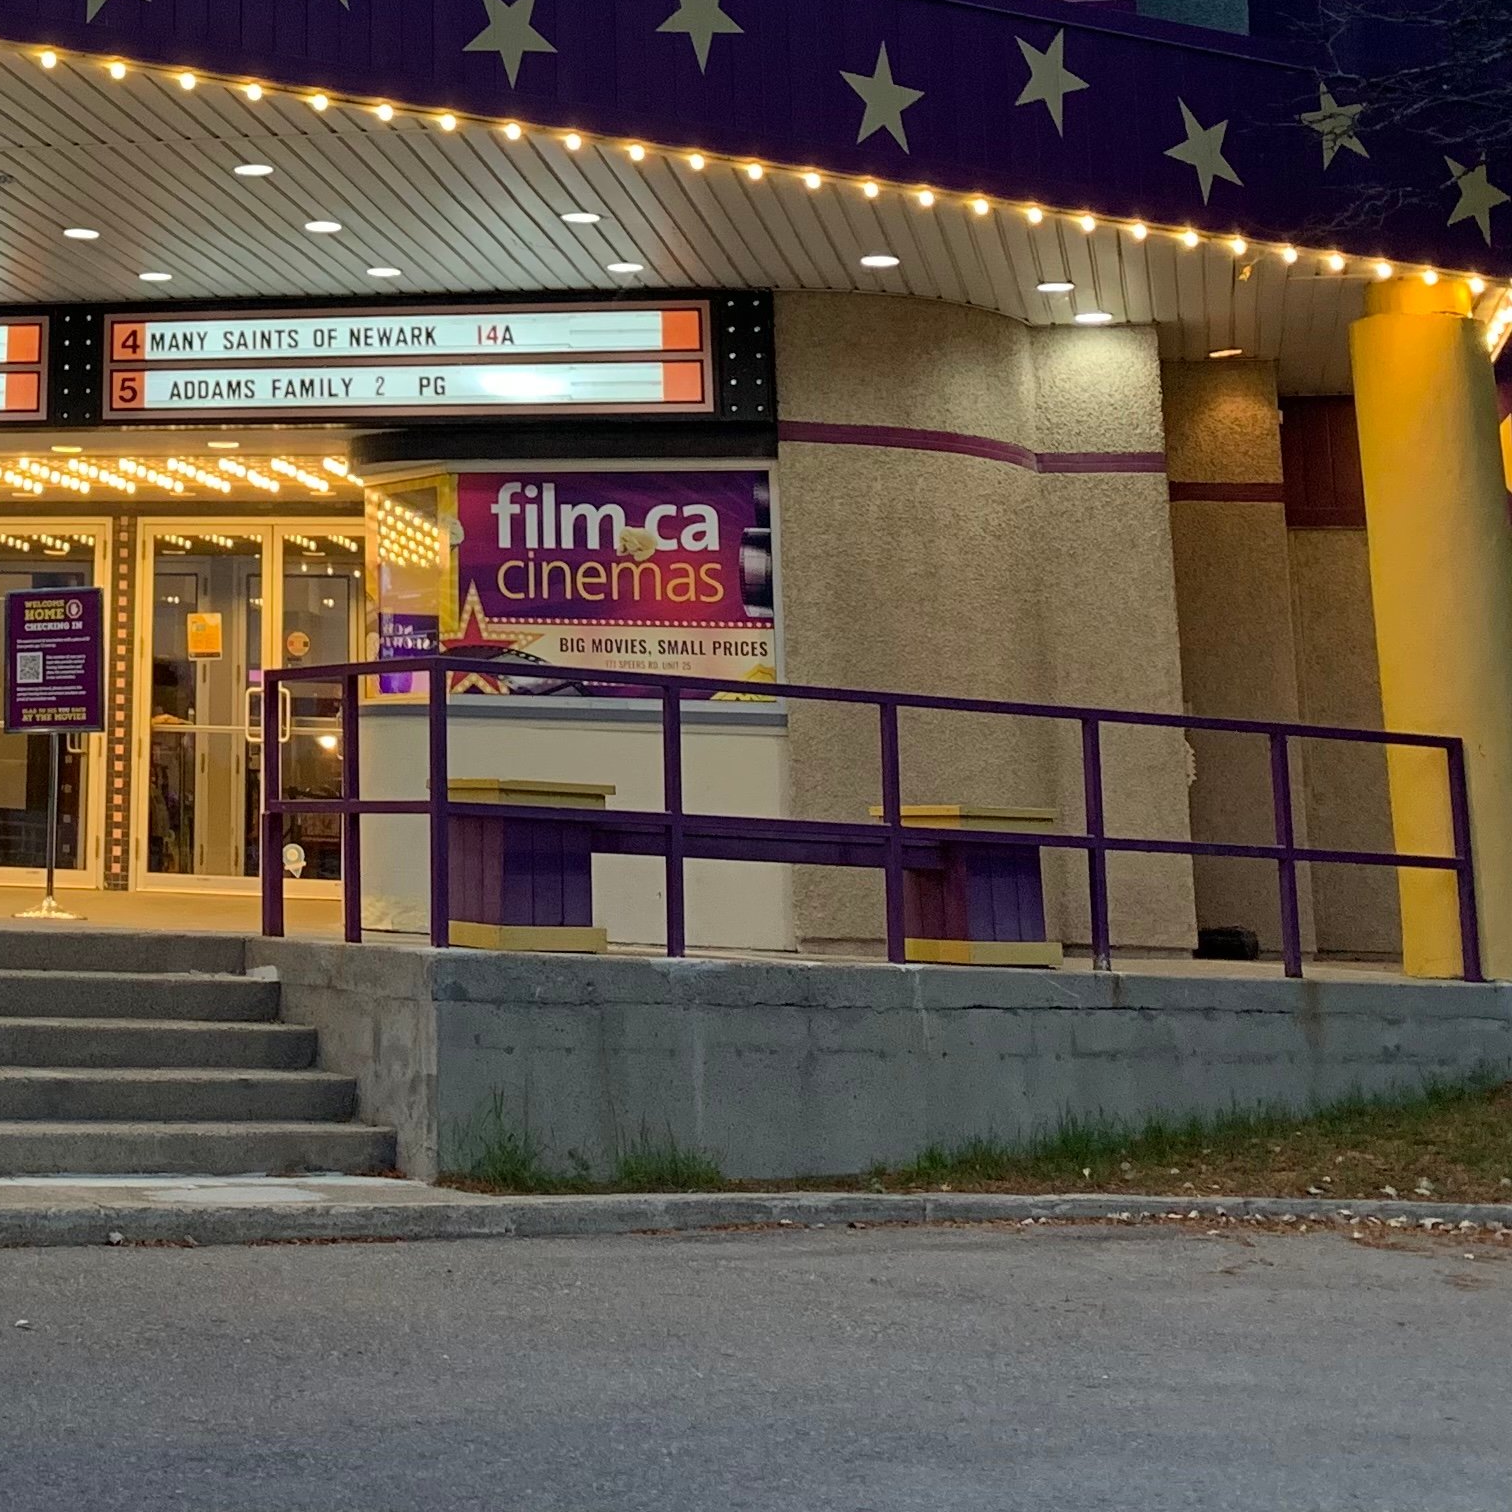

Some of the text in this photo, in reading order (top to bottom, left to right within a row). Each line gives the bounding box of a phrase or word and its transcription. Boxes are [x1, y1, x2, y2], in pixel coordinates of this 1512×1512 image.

[121, 329, 141, 355] 4
[150, 323, 515, 352] MANY SAINTS OF NEWARK 14A
[118, 377, 138, 403] 5
[169, 375, 446, 401] ADDAMS FAMILY 2 PG
[497, 550, 725, 603] cinemas
[24, 600, 65, 608] WELCOME
[24, 608, 65, 621] HOME
[24, 621, 83, 631] CHECKING IN
[559, 637, 768, 657] BIG MOVIES, SMALL PRICES
